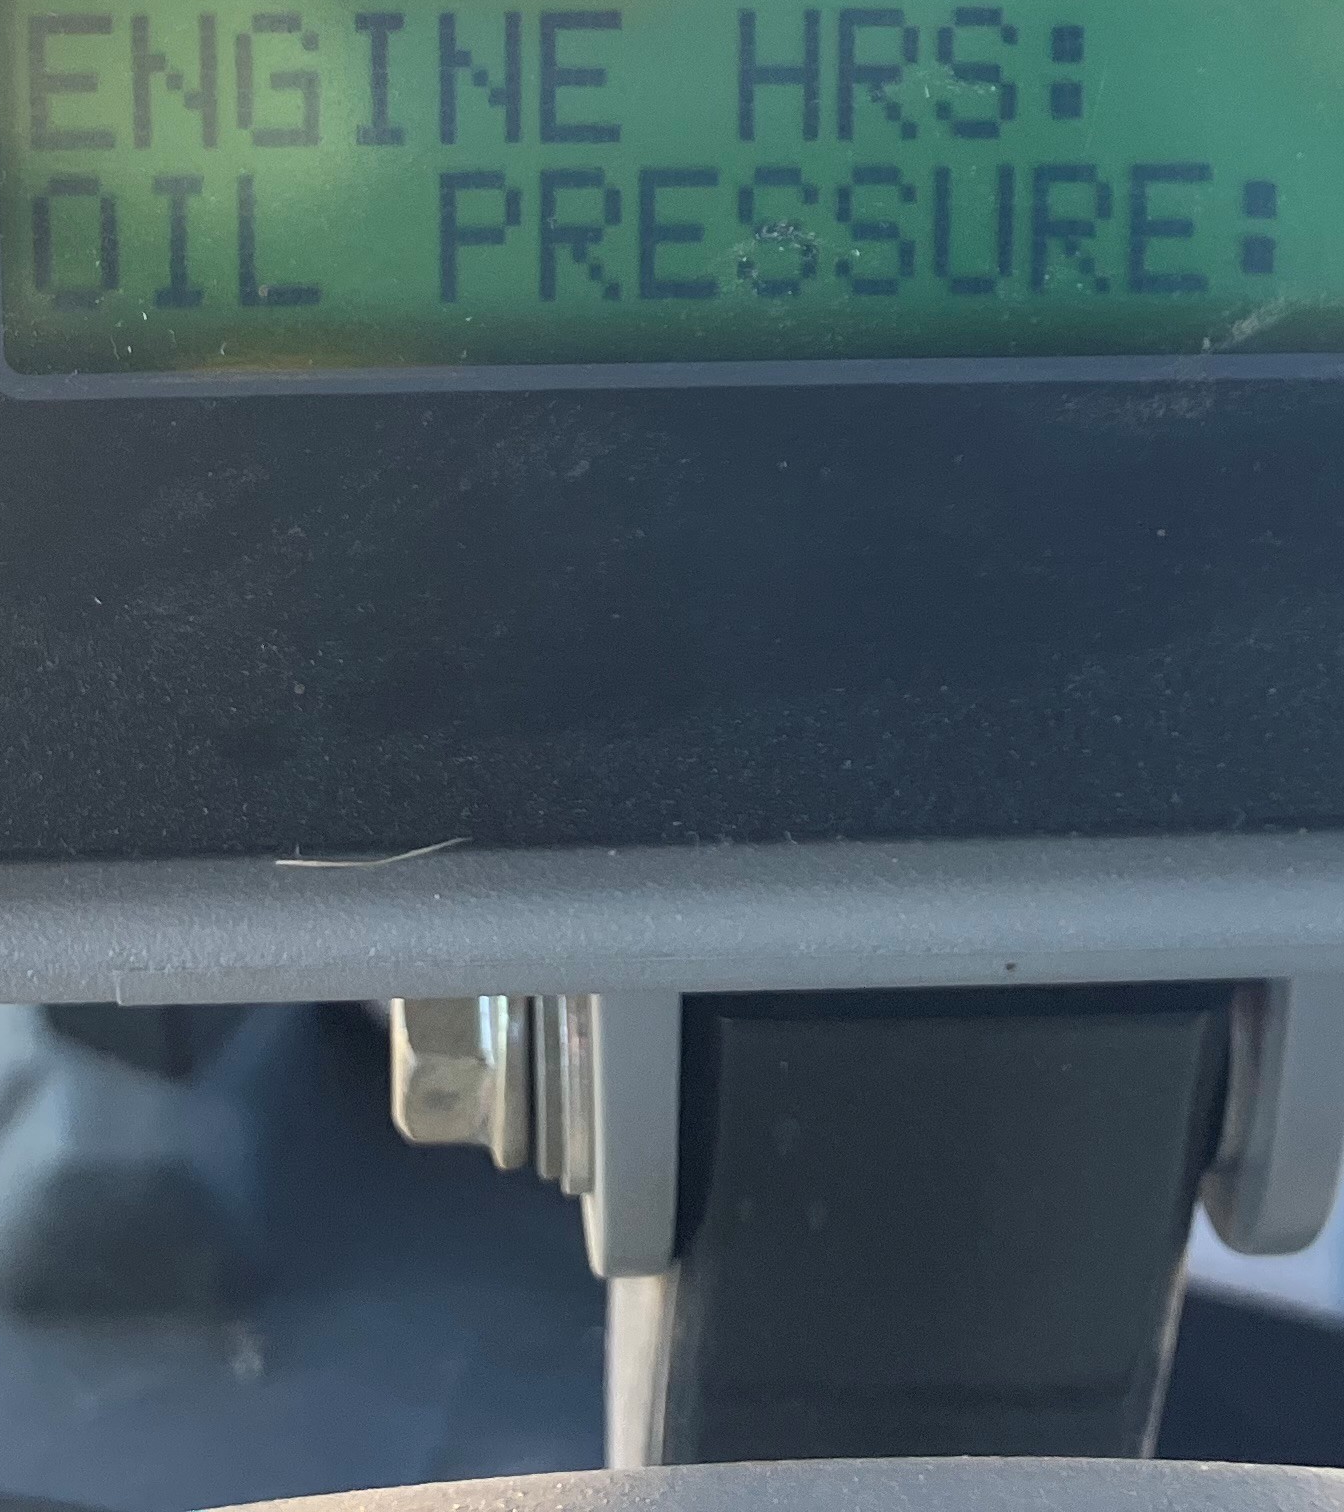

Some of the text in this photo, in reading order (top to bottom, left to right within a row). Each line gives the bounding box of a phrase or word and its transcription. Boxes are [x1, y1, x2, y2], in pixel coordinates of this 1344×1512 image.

[26, 8, 623, 150] ENGINE
[736, 6, 1088, 142] HRS:
[30, 172, 322, 310] OIL
[436, 160, 1280, 306] PRESSURE:
